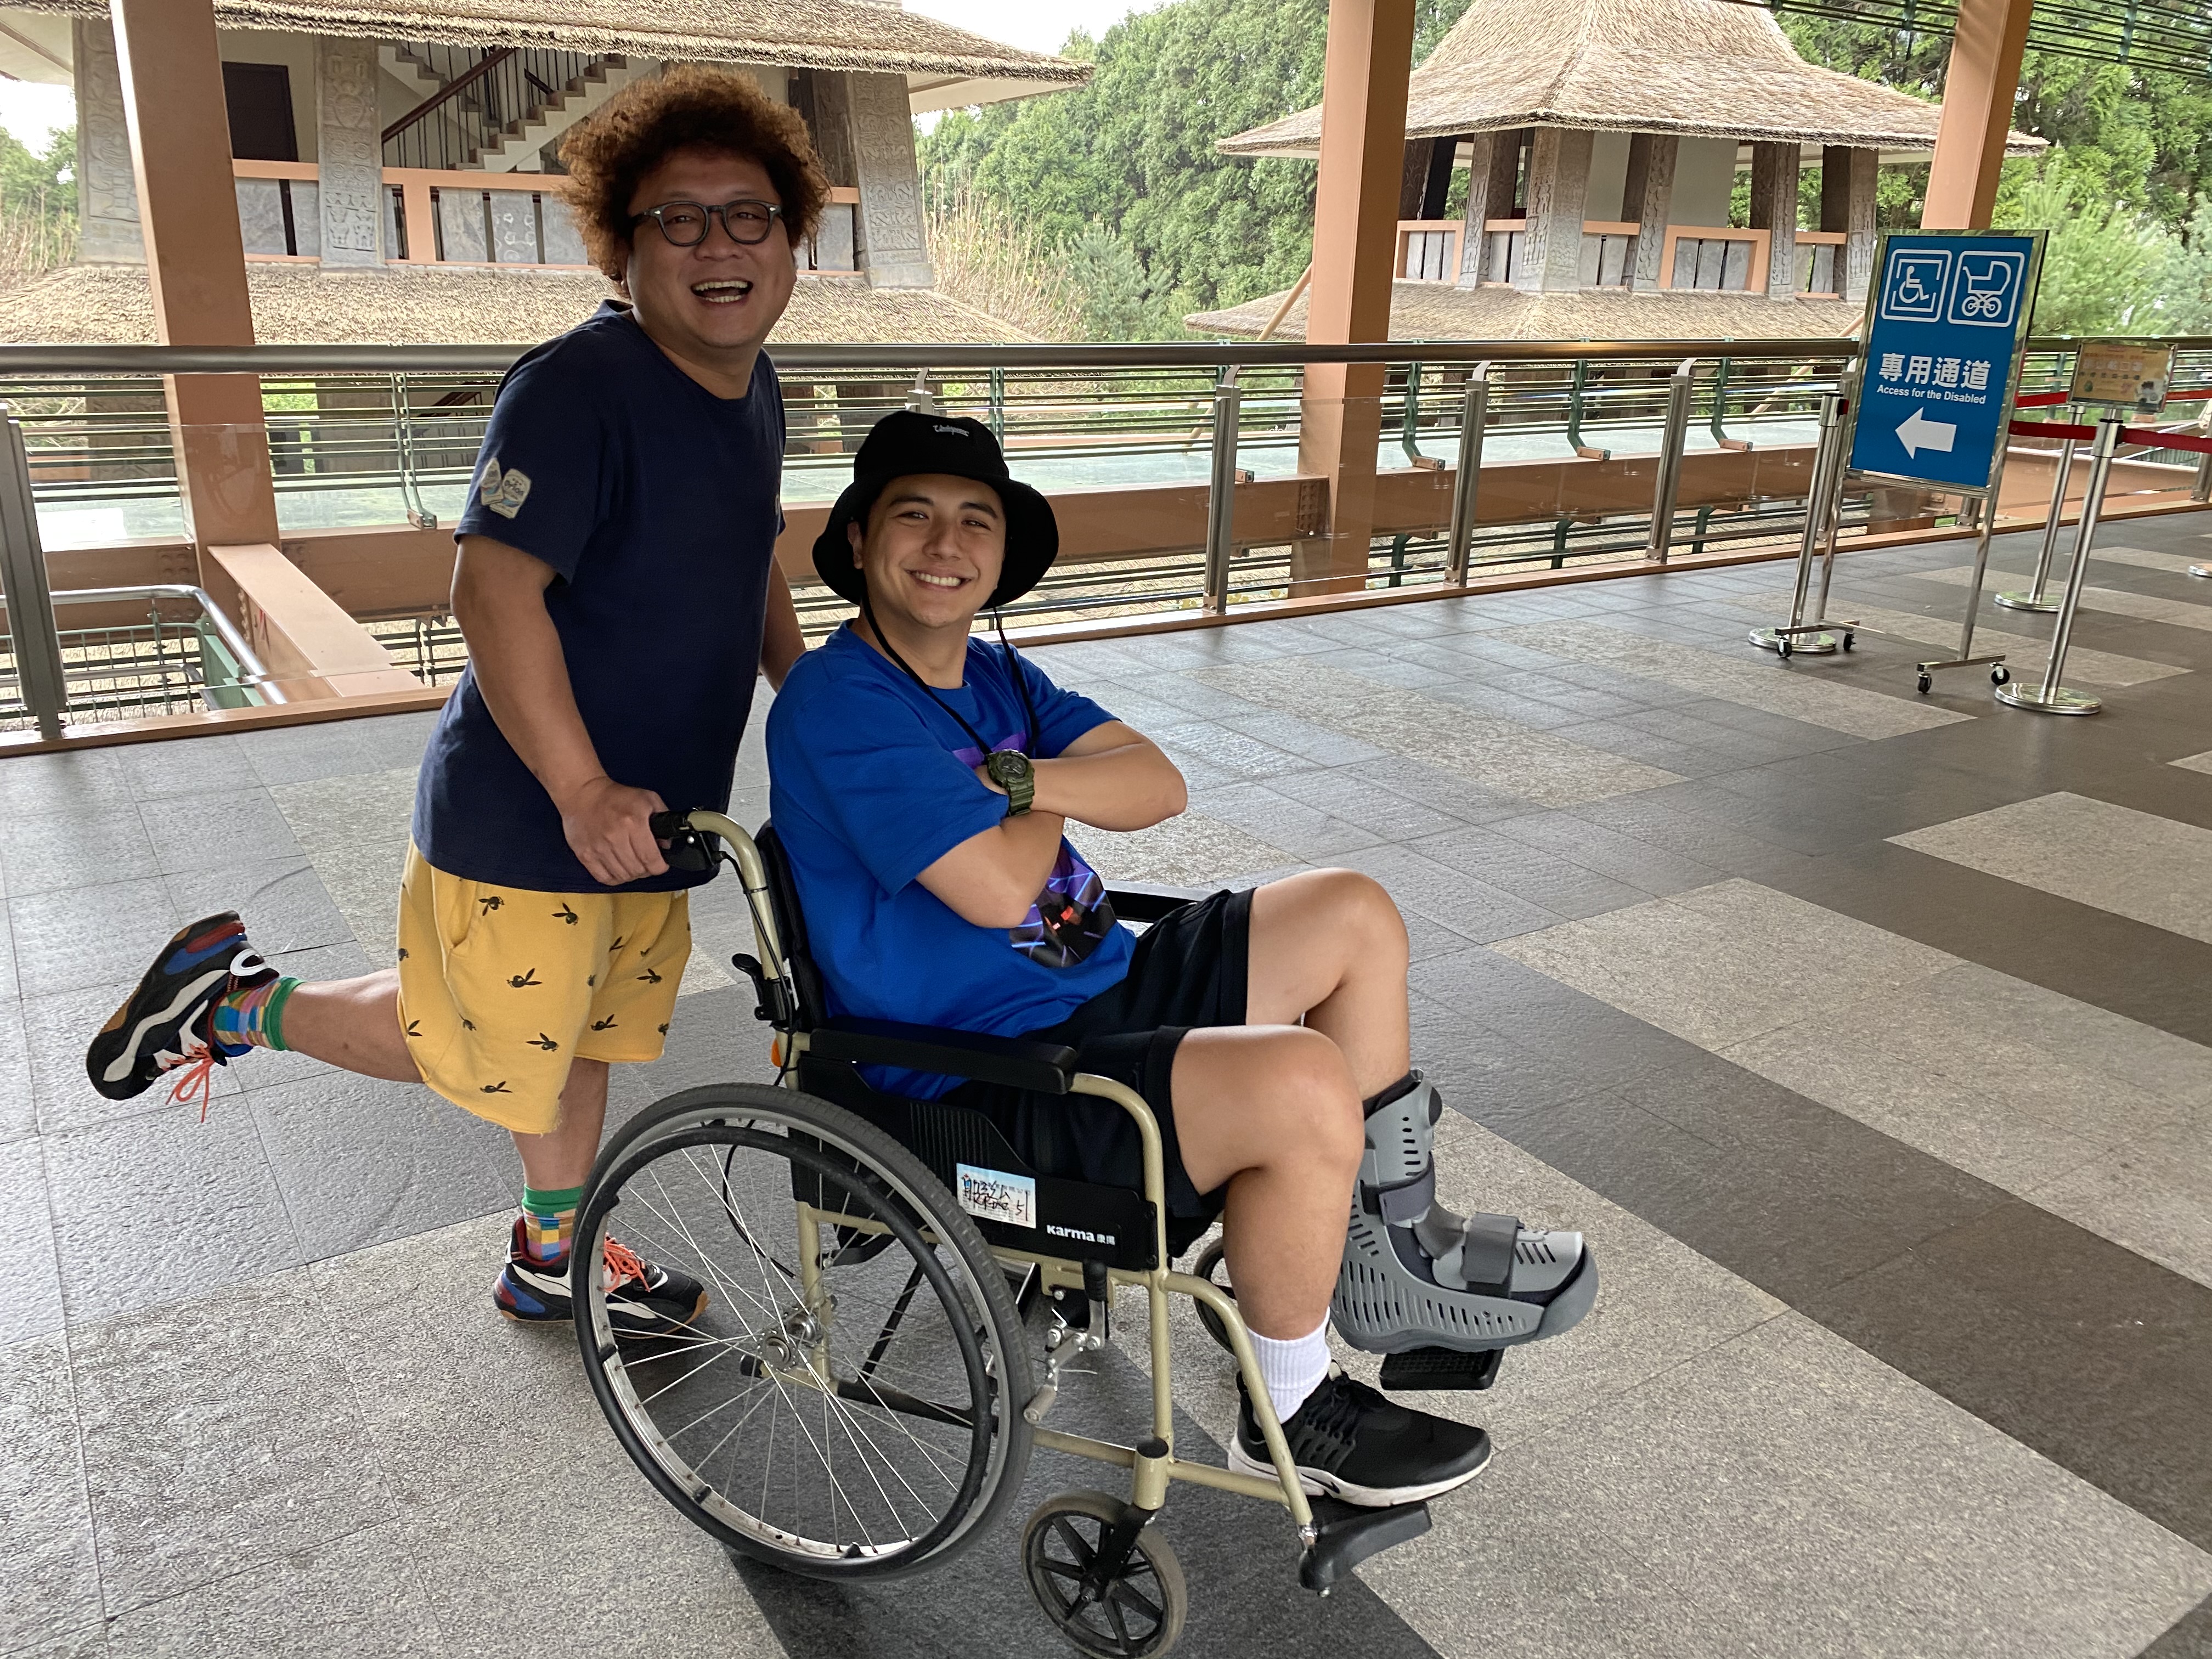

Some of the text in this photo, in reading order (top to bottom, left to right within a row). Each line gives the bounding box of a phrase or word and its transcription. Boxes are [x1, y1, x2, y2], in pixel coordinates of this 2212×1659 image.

[1878, 353, 1991, 391] 專用通道
[1877, 384, 1987, 404] Access for the Disabled
